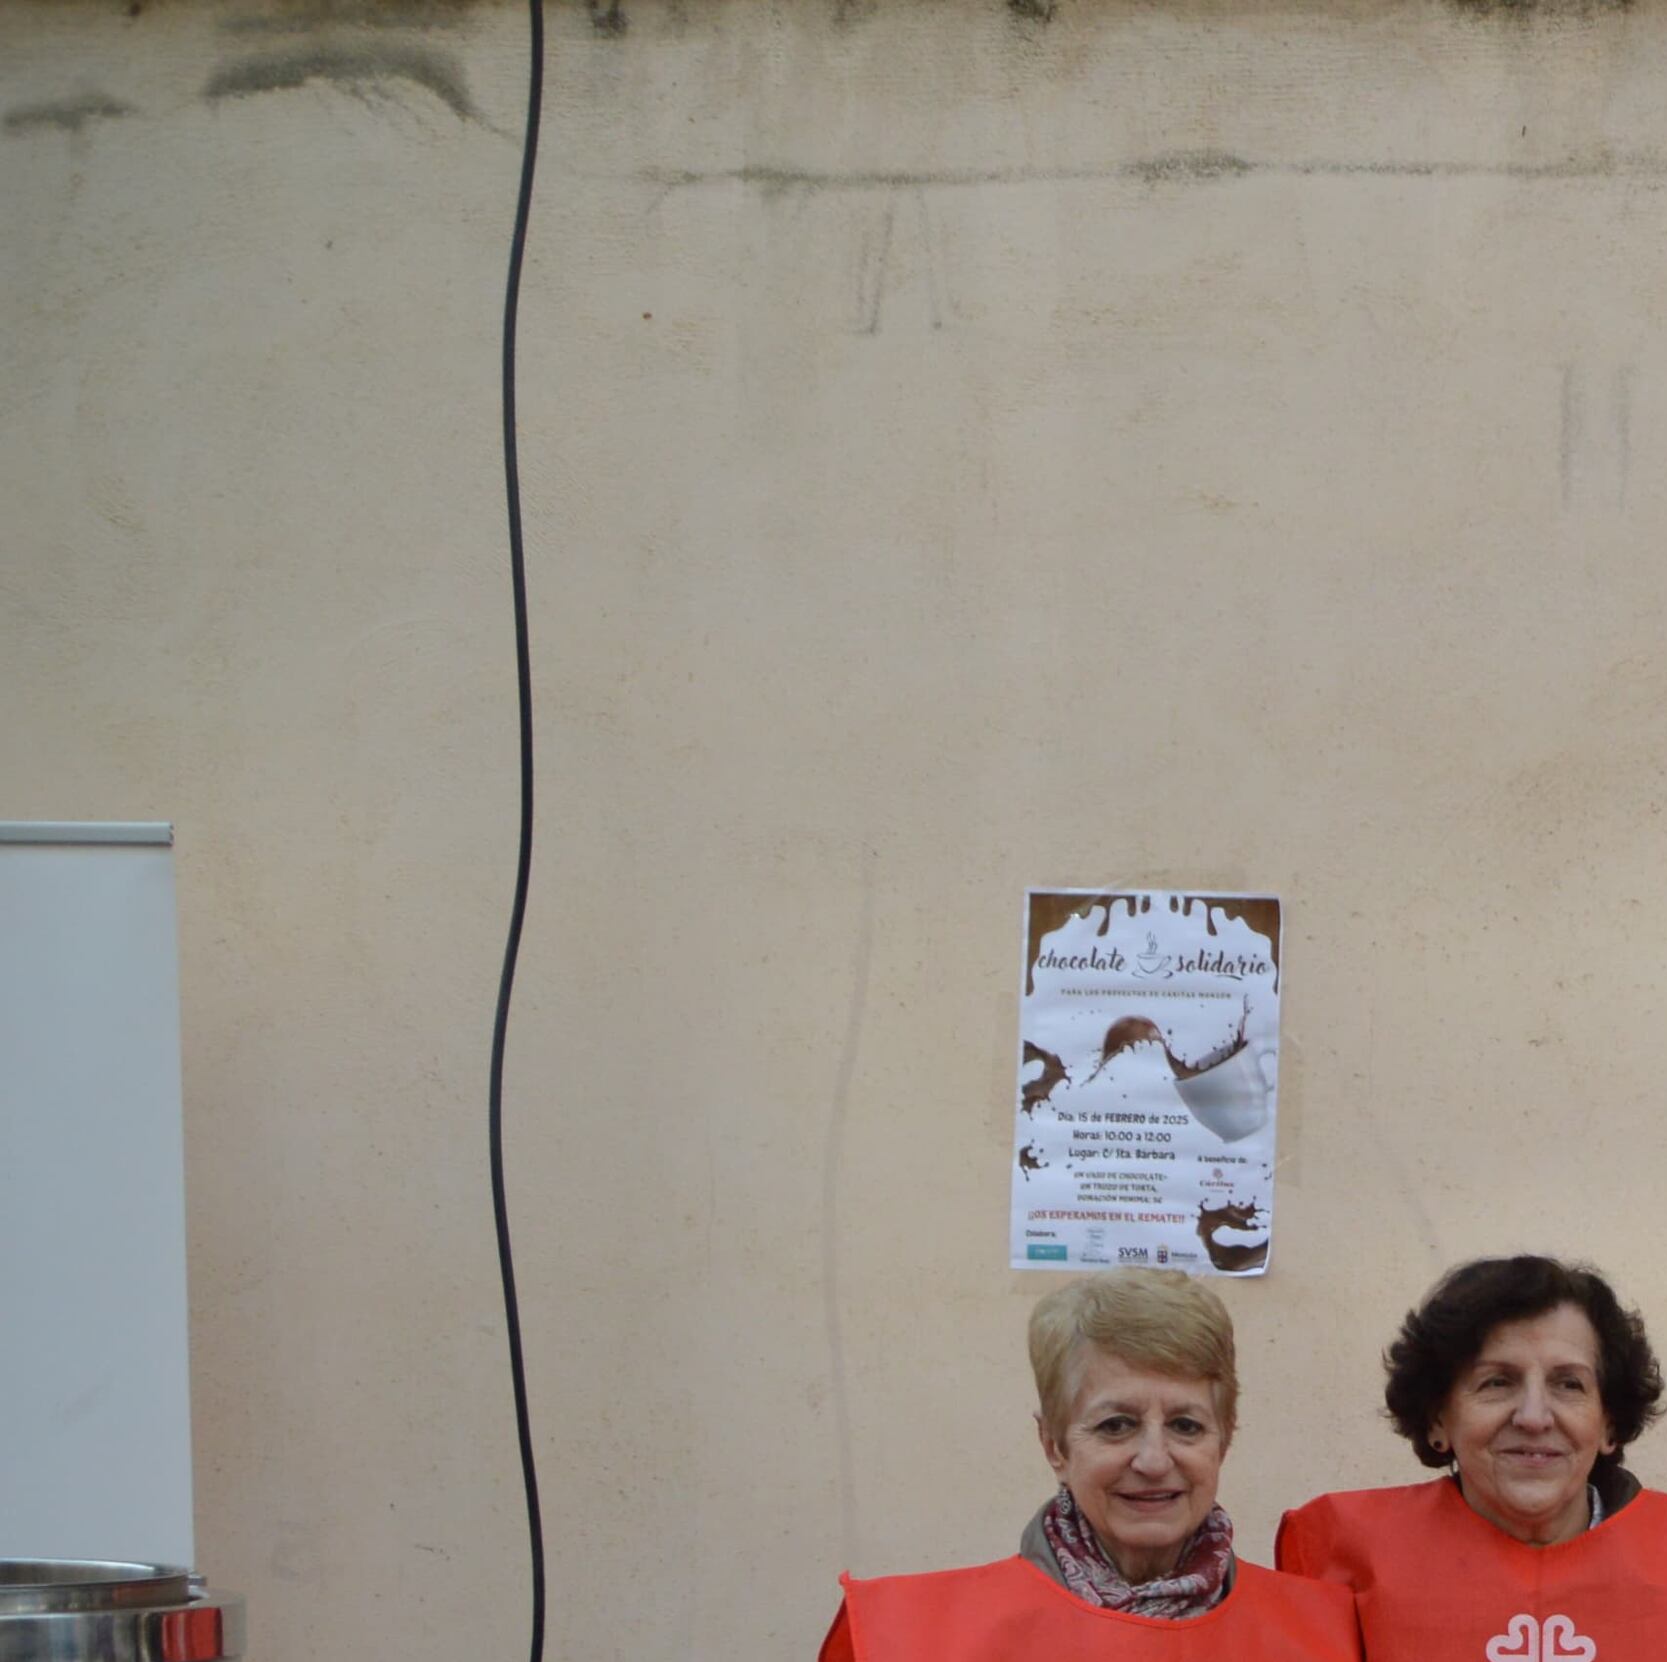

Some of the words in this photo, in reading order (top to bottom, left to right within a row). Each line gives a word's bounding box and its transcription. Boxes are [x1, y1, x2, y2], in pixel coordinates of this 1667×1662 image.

[1038, 946, 1125, 972] chocolate
[1175, 948, 1268, 980] solidario
[1078, 1113, 1089, 1123] 15
[1090, 1112, 1102, 1123] de
[1104, 1113, 1146, 1124] FEBRERO
[1148, 1113, 1160, 1125] de
[1162, 1115, 1189, 1126] 2025
[1104, 1131, 1133, 1142] 10:00
[1144, 1132, 1172, 1143] 12:00
[1050, 1210, 1108, 1222] ESPERAMOS
